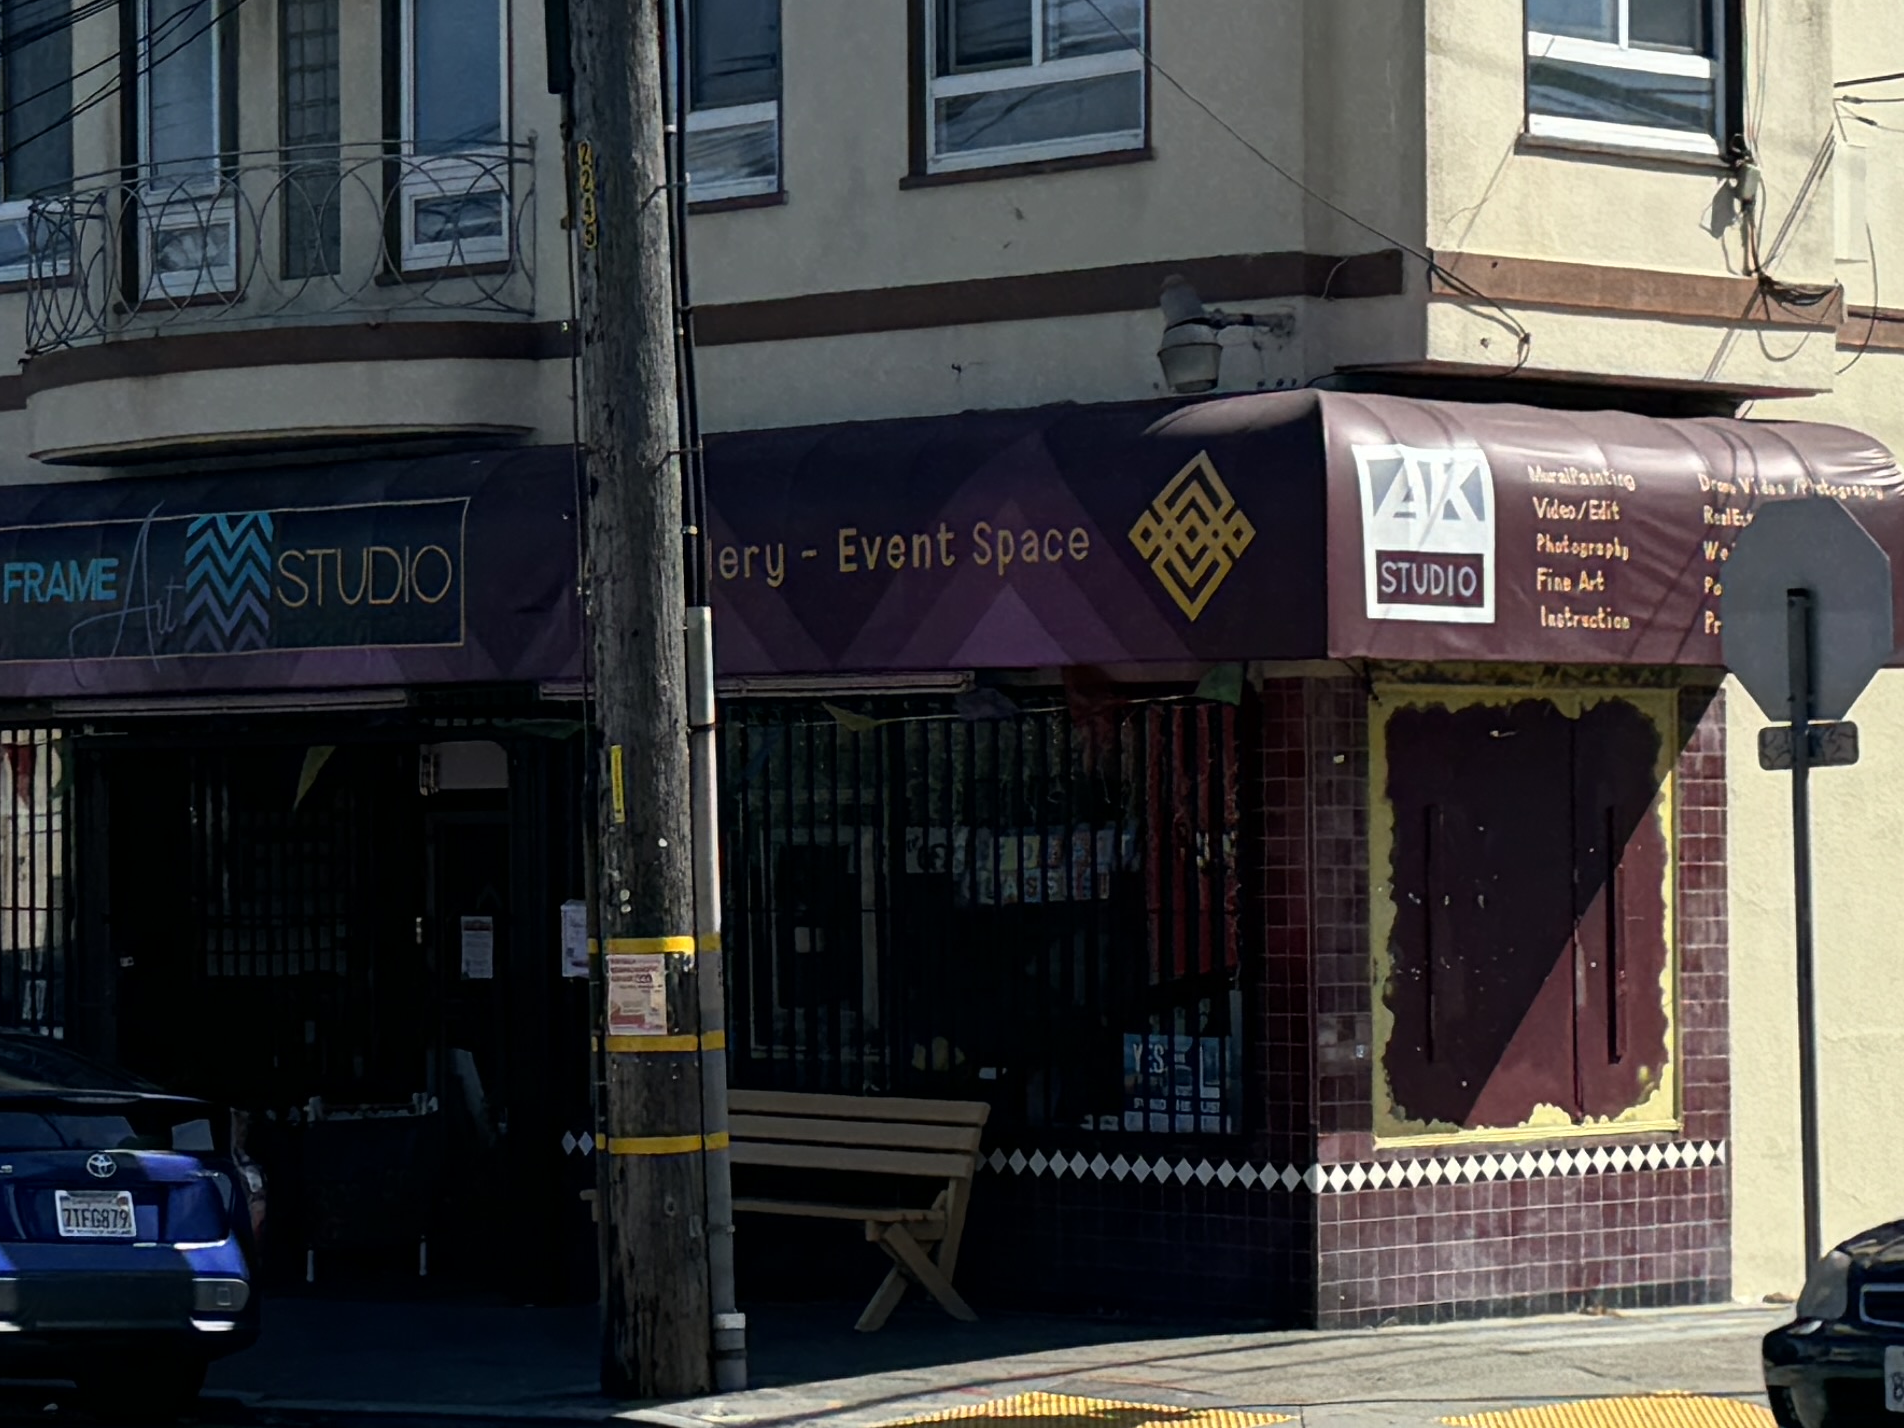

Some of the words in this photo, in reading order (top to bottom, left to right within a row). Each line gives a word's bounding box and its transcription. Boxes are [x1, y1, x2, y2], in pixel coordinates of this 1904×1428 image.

[837, 522, 956, 573] Event
[972, 521, 1090, 577] Space
[1536, 532, 1630, 562] Photography
[3, 557, 120, 605] FRAME
[68, 500, 187, 690] Art
[276, 544, 453, 608] STUDIO
[1380, 560, 1478, 598] STUDIO
[1536, 566, 1573, 592] Fine
[1578, 569, 1606, 592] Art
[1540, 604, 1631, 630] Instruction
